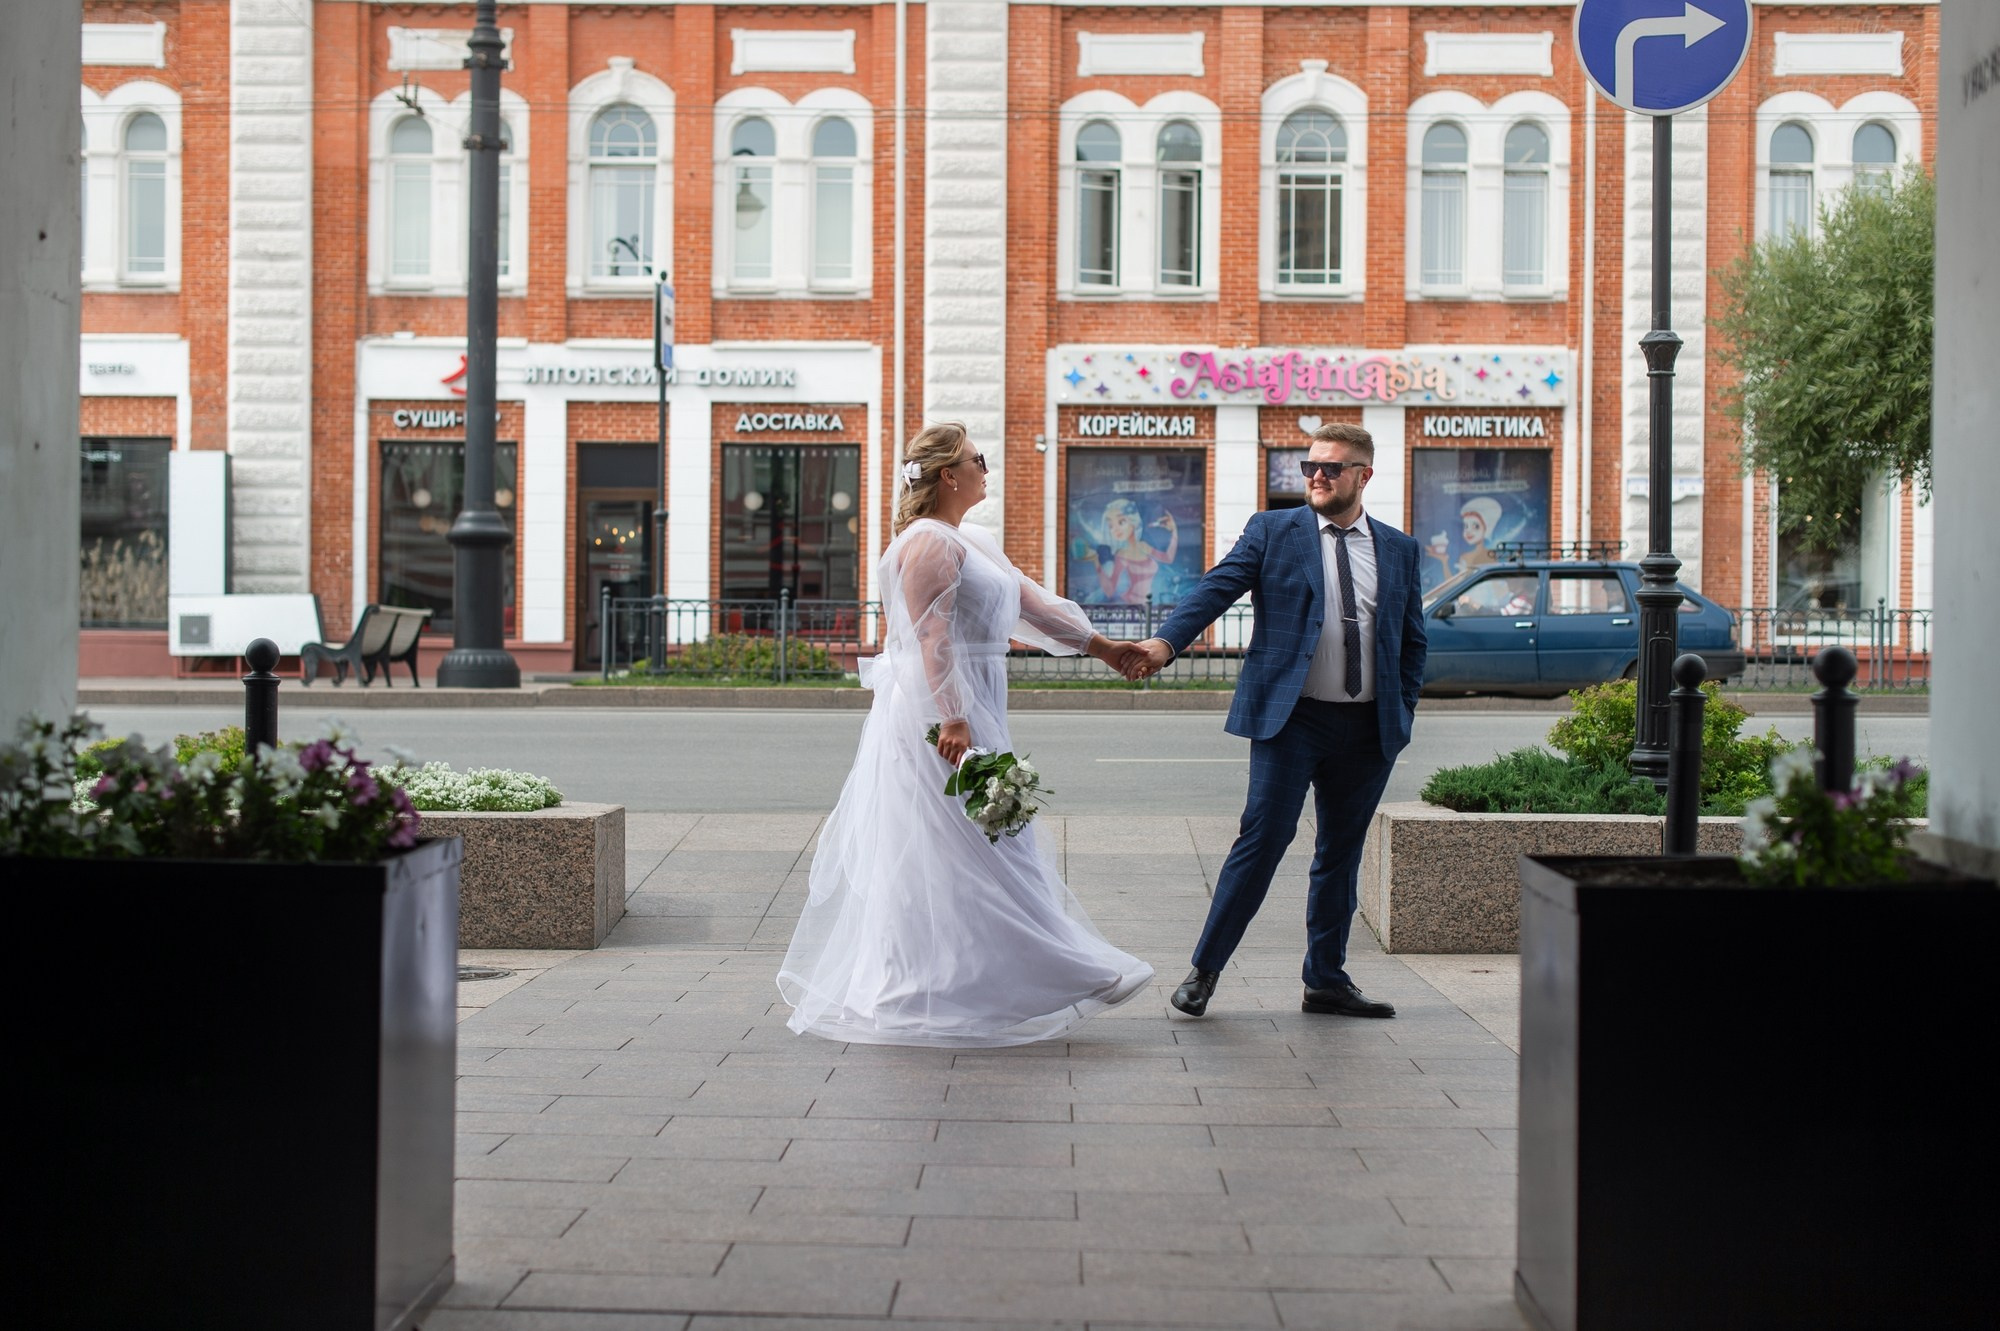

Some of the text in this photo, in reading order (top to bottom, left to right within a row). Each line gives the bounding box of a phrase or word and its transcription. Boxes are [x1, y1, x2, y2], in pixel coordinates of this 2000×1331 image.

[1171, 351, 1456, 405] Asiafantasia
[393, 409, 501, 428] СУШИ-
[735, 412, 843, 432] ДОСТАВКА
[1079, 412, 1195, 436] КОРЕЙСКАЯ
[1424, 416, 1544, 437] КОСМЕТИКА
